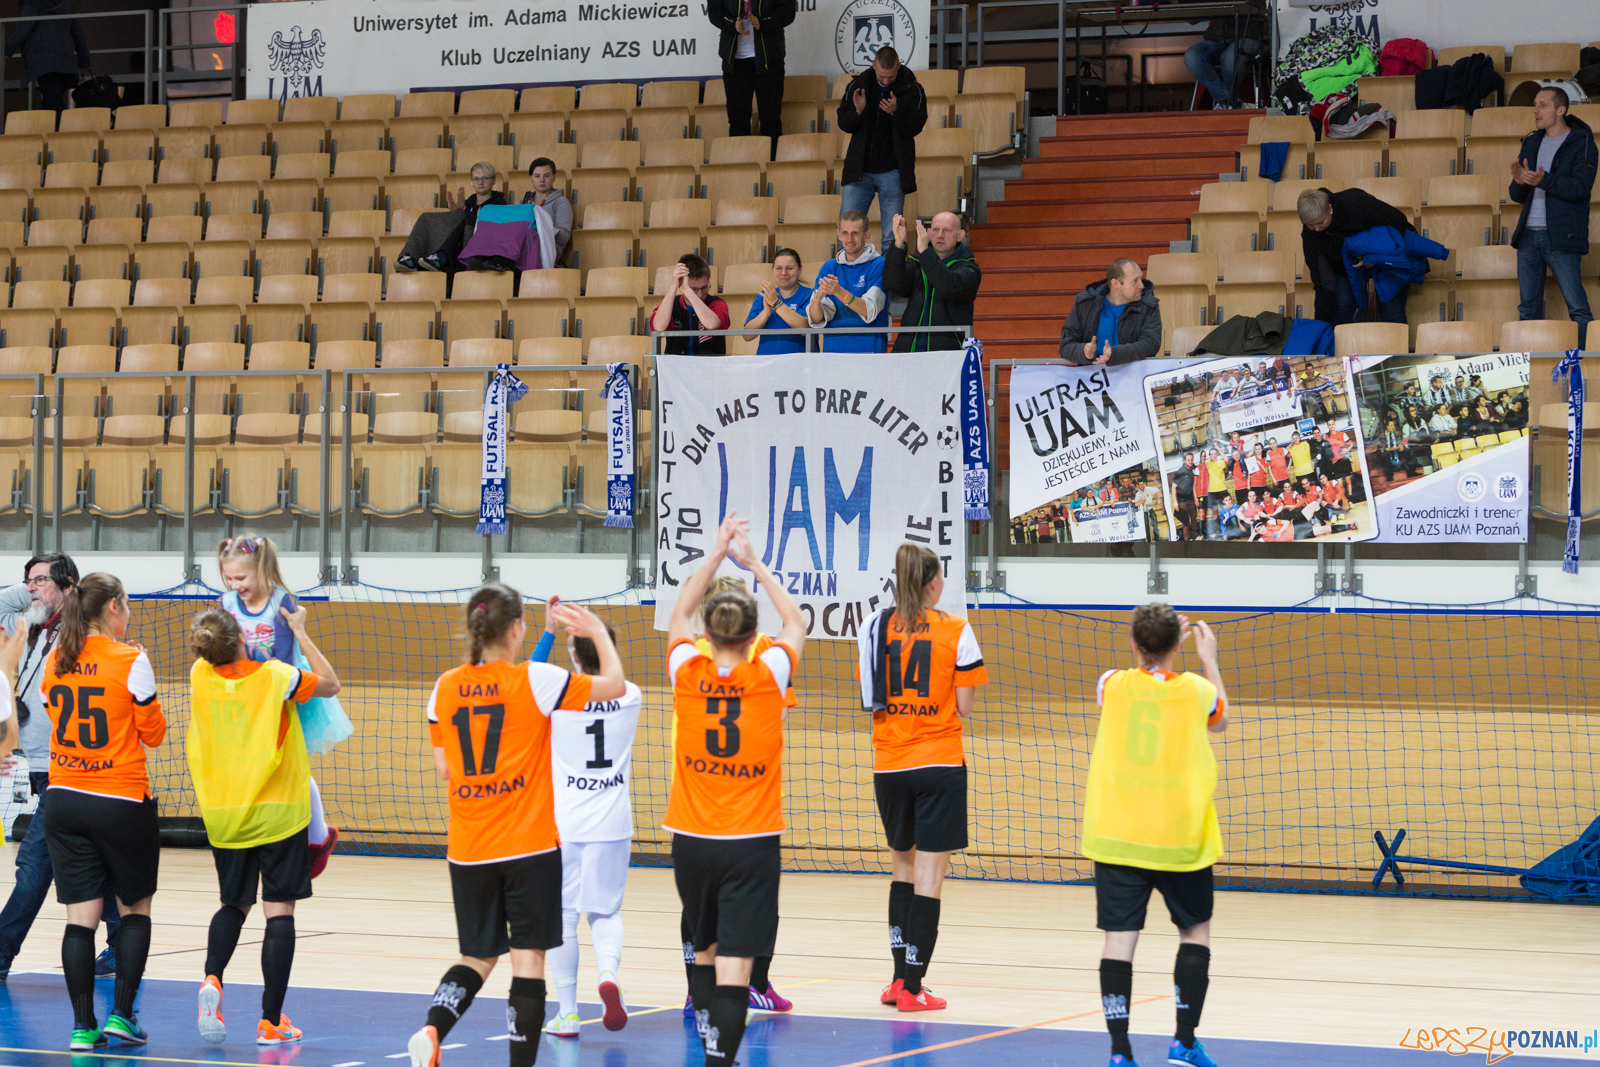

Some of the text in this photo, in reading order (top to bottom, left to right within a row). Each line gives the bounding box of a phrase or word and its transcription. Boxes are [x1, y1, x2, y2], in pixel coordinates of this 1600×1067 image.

[353, 15, 458, 34] Uniwersytet
[469, 13, 493, 29] im.
[504, 9, 566, 27] Adama
[578, 3, 689, 21] Mickiewicza
[441, 38, 697, 66] Klub Uczelniany AZS UAM
[1456, 352, 1530, 376] Adam Mick
[969, 379, 979, 421] UAM
[1015, 368, 1110, 422] ULTRASI
[1265, 412, 1290, 423] Weissa
[486, 411, 498, 473] FUTSAL
[613, 404, 623, 469] FUTSAL
[681, 423, 716, 465] DLA
[716, 393, 760, 427] WAS
[774, 389, 806, 415] TO
[868, 398, 929, 456] LITER
[969, 425, 981, 459] AZS
[1025, 390, 1125, 457] UAM
[1112, 426, 1129, 442] ŻE
[1044, 440, 1140, 490] JESTEŚCIE Z NAMI
[717, 442, 874, 571] UAM
[1395, 522, 1520, 536] KU AZS UAM Poznań
[1396, 506, 1522, 519] Zawodniczki i trener
[675, 507, 705, 566] DLA
[71, 662, 98, 675] AM
[459, 683, 499, 697] UAM
[700, 680, 744, 695] UAM
[886, 639, 932, 698] 14
[49, 684, 109, 750] 25
[704, 697, 741, 758] 3
[886, 702, 939, 716] OZNAŃ
[1126, 700, 1162, 767] 6
[451, 703, 505, 777] 17
[585, 719, 613, 769] 1
